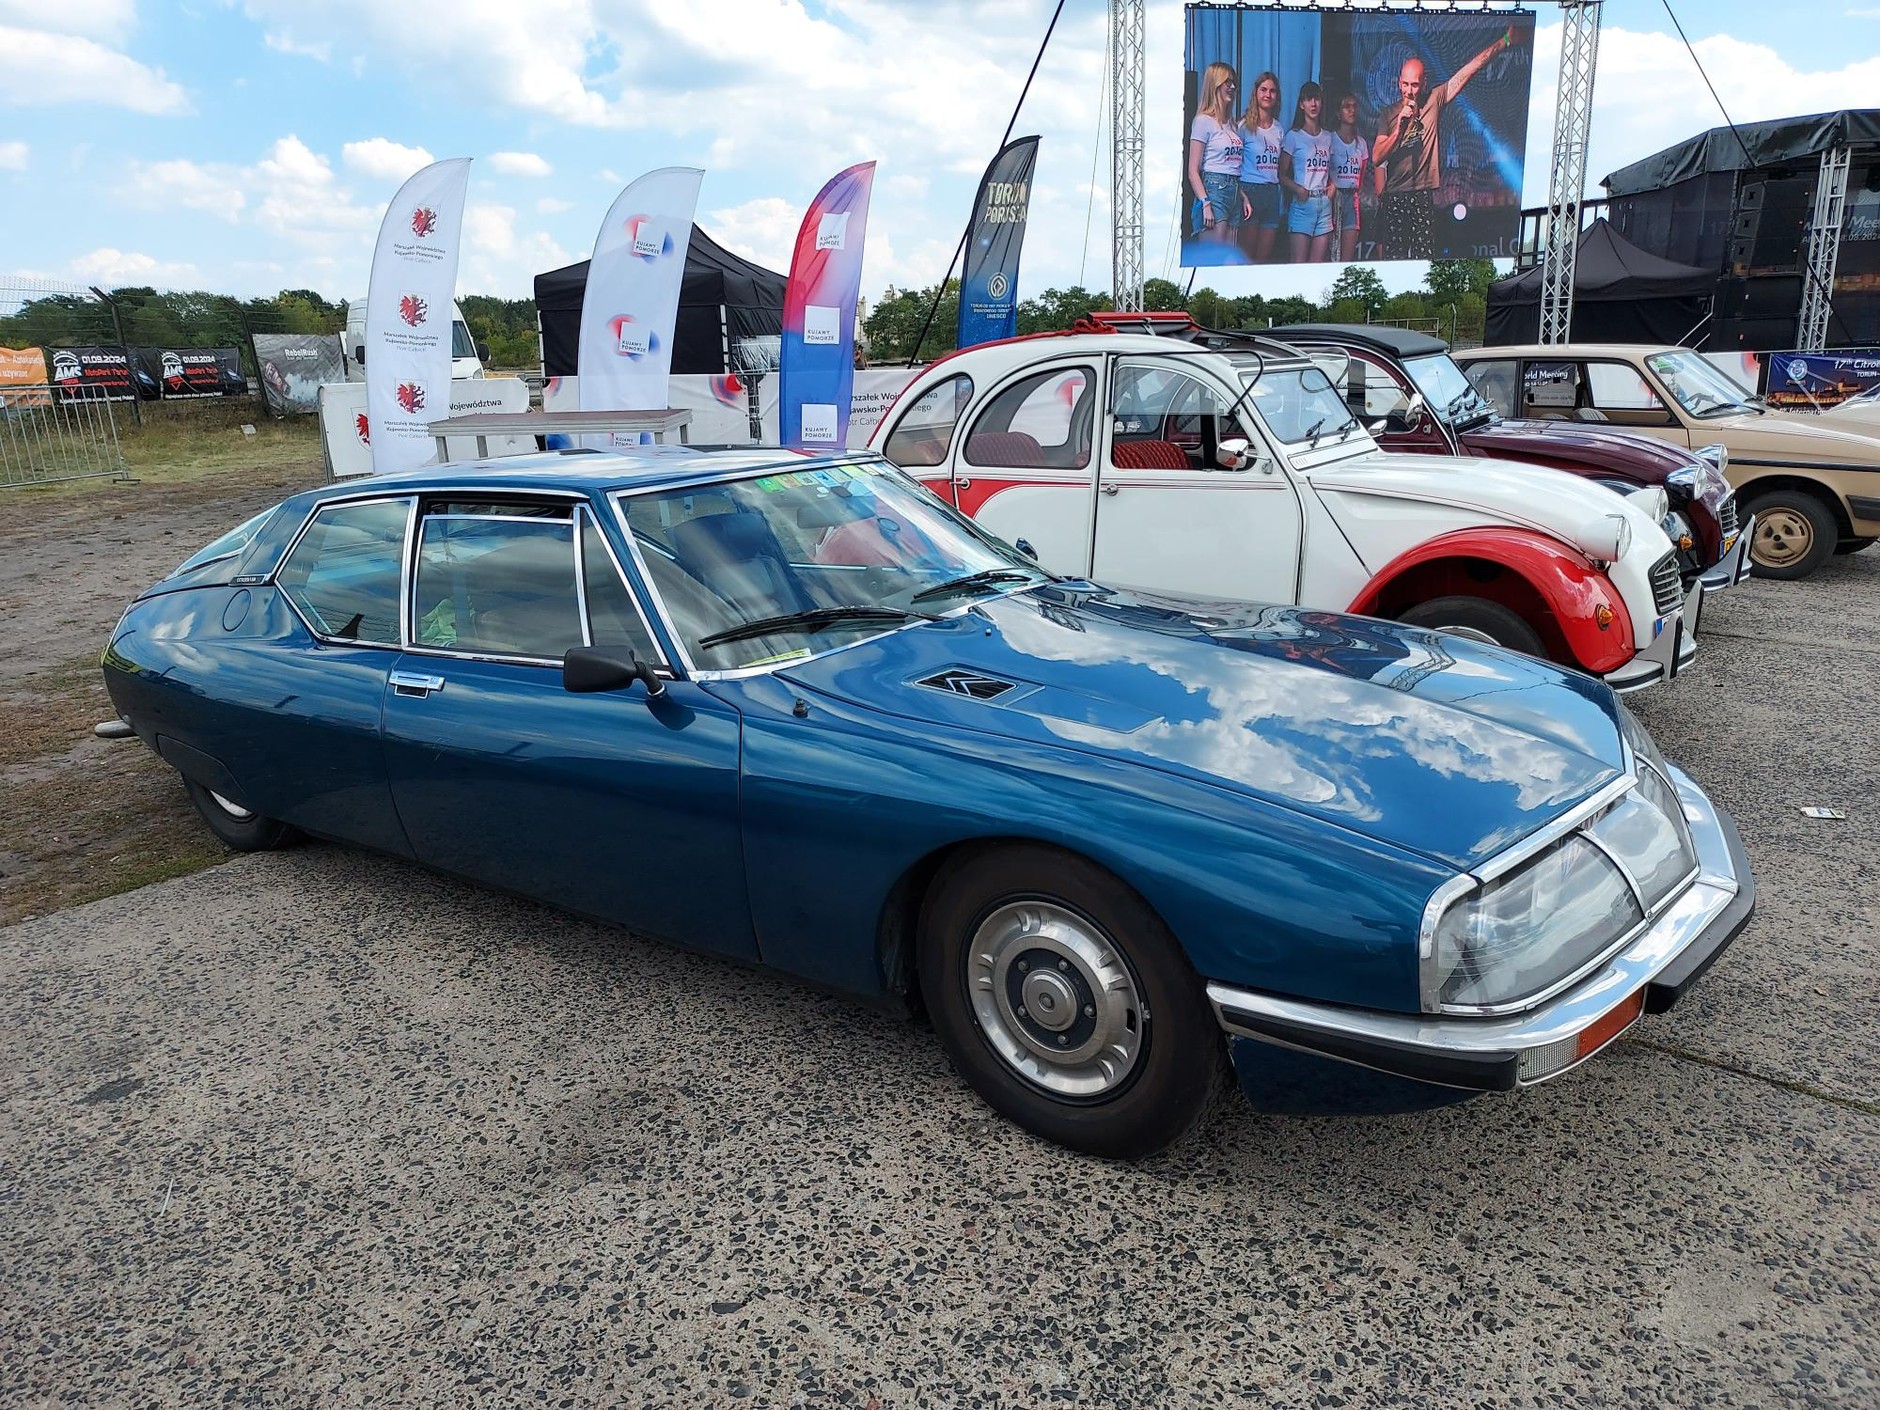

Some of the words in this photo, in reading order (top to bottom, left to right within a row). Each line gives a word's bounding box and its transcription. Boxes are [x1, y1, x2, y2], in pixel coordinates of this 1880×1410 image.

[1255, 155, 1267, 165] 20
[1306, 158, 1317, 168] 20
[1337, 165, 1348, 174] 20
[635, 245, 660, 255] POMORZE
[1355, 241, 1376, 260] 17
[621, 344, 647, 353] POMORZE
[82, 355, 127, 364] 01.09.2024
[182, 355, 216, 364] 01.09.2024
[54, 365, 83, 381] AMS
[163, 365, 185, 379] AMS
[851, 394, 879, 402] rszałek
